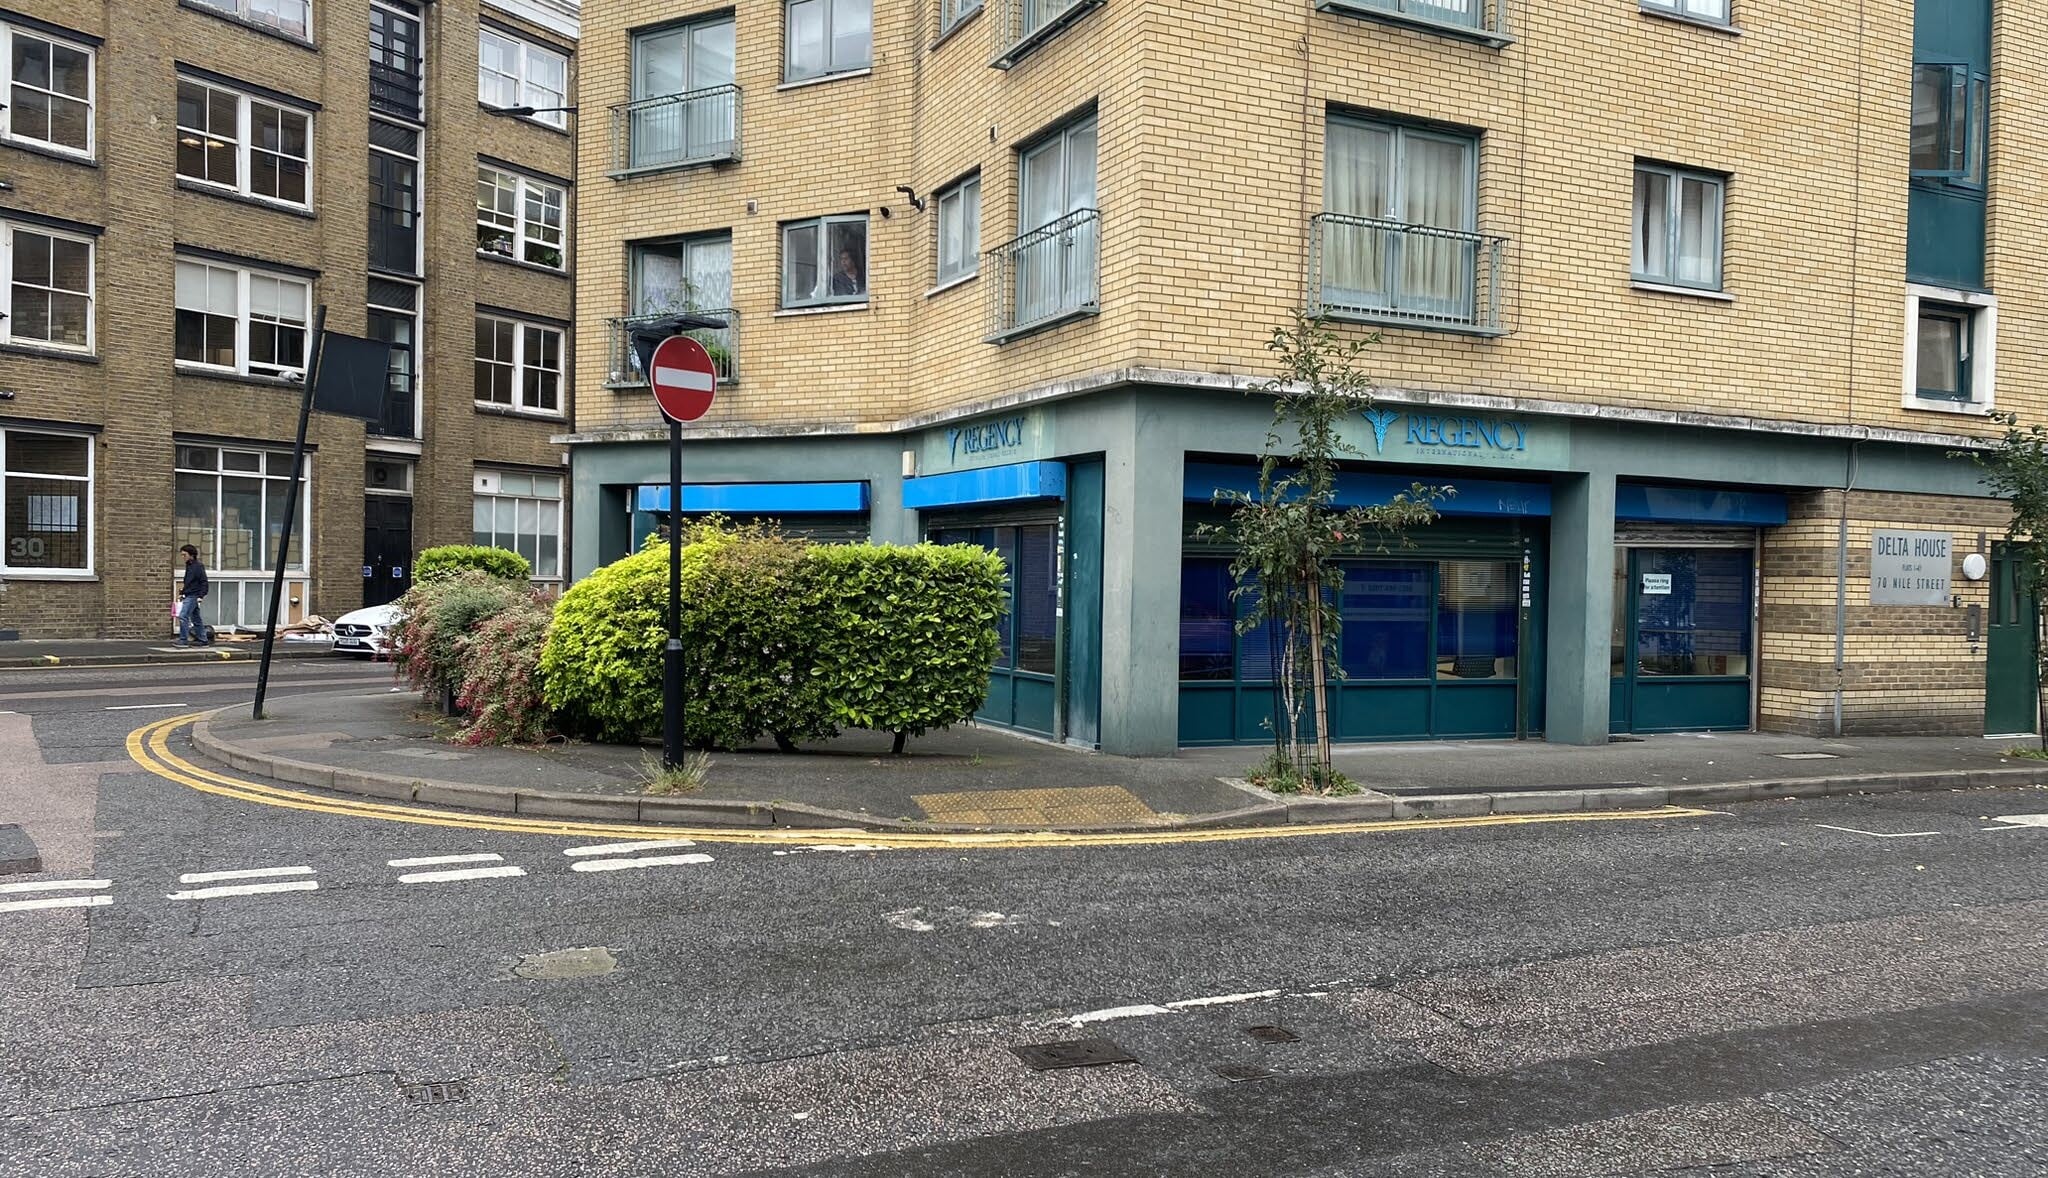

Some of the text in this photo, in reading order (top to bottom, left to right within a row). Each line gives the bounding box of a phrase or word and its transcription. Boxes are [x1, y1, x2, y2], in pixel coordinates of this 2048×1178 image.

[963, 416, 1025, 454] REGENCY
[1405, 414, 1532, 451] REGENCY
[10, 537, 45, 557] 30
[1878, 536, 1946, 558] DELTA HOUSE
[1877, 577, 1945, 590] 70 NILE STREET
